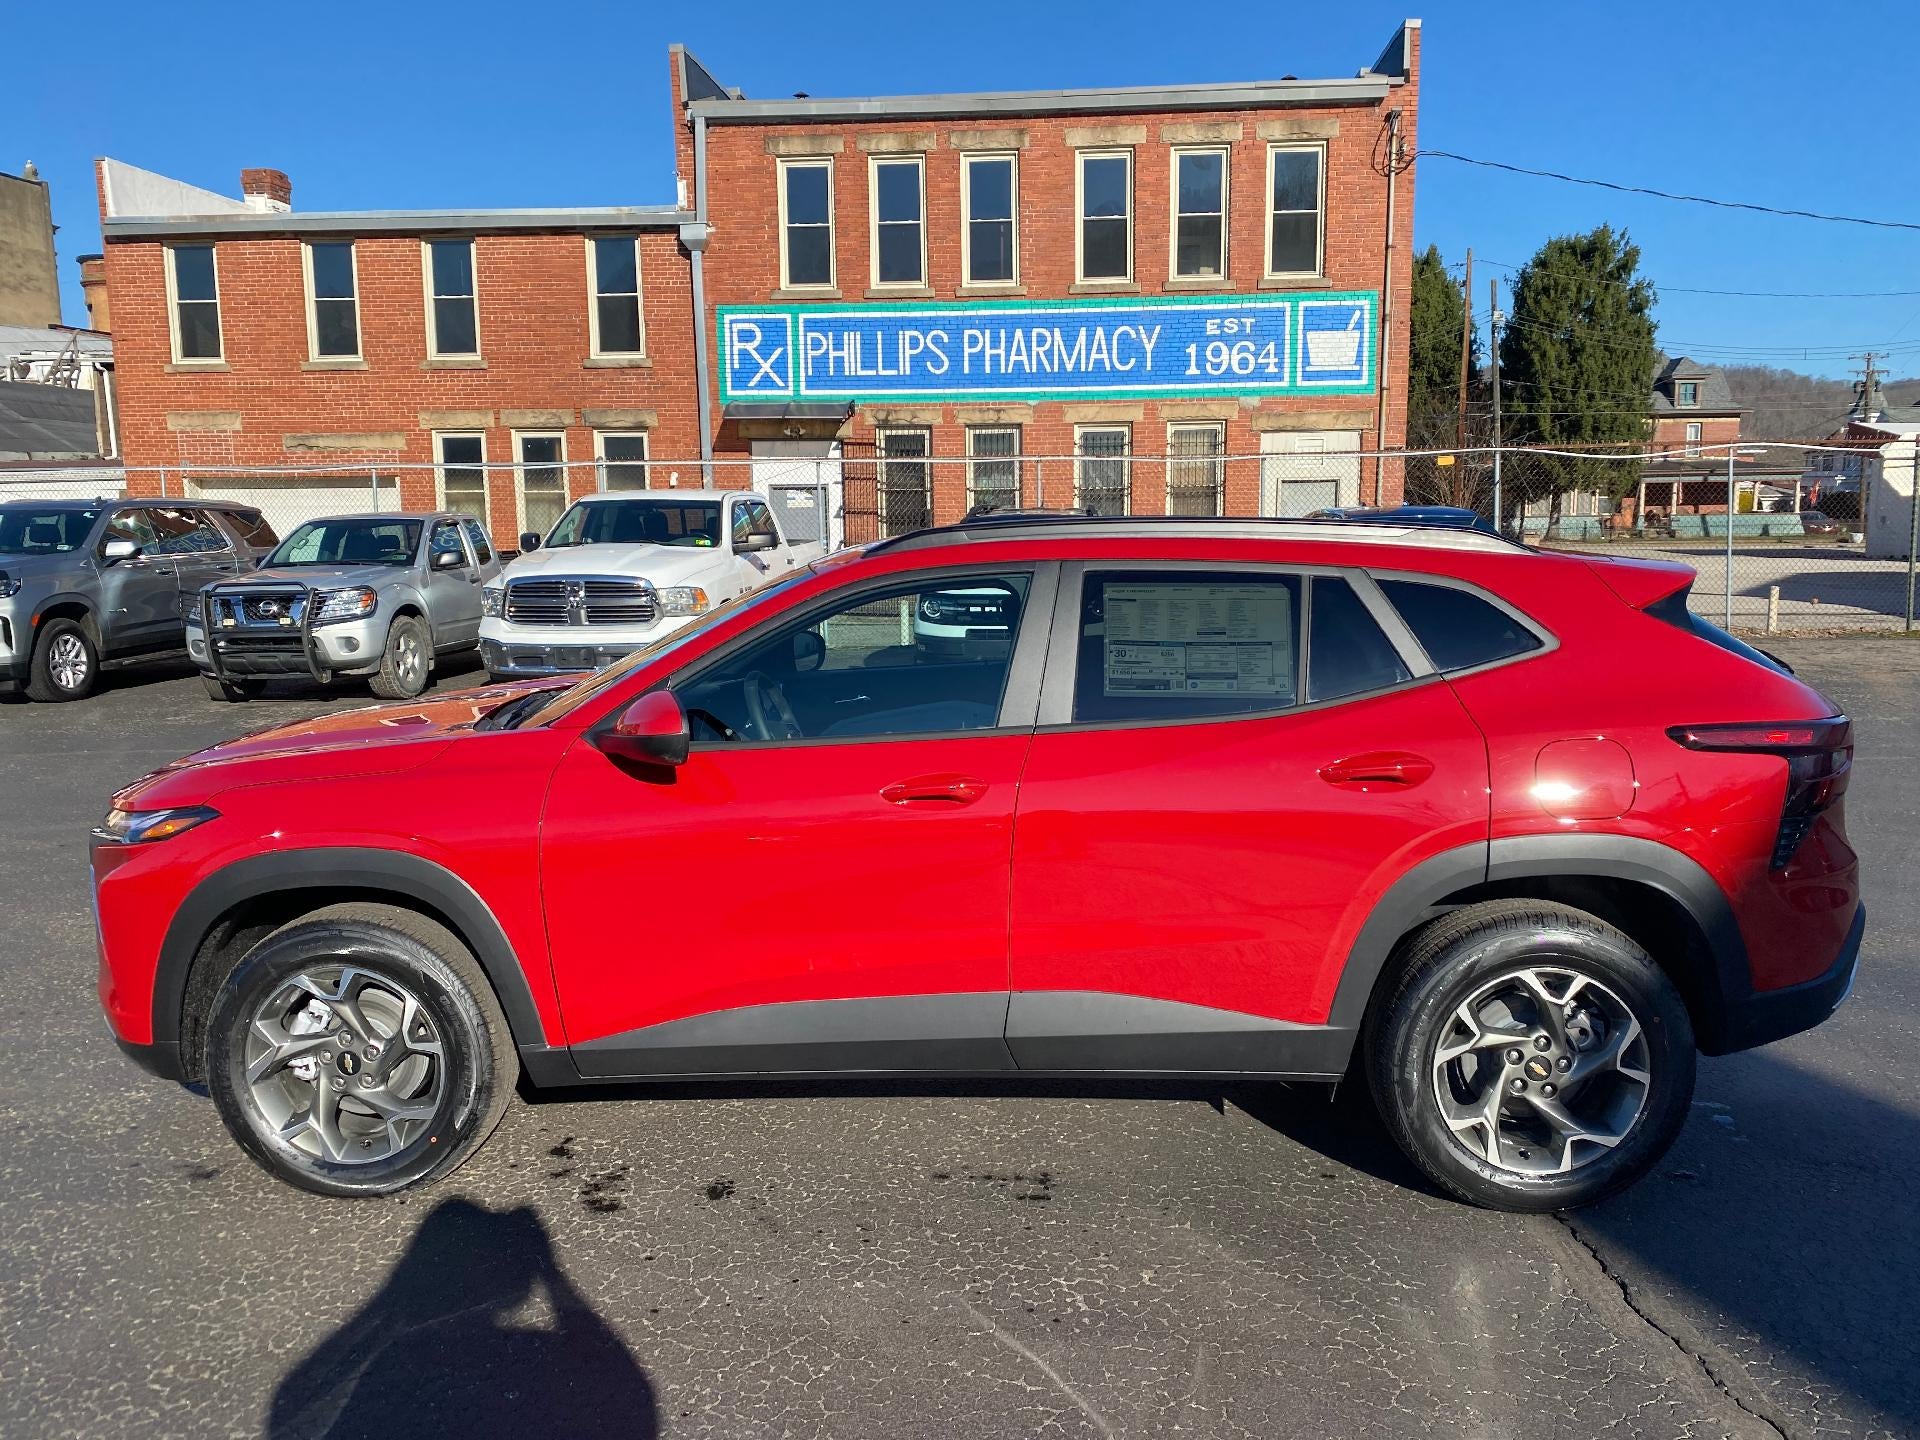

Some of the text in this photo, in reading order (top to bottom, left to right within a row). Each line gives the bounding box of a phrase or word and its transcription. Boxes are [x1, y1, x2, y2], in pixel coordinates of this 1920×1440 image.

[1206, 318, 1255, 335] EST
[807, 325, 1161, 376] PHILLIPS PHARMACY
[1185, 341, 1279, 375] 1964
